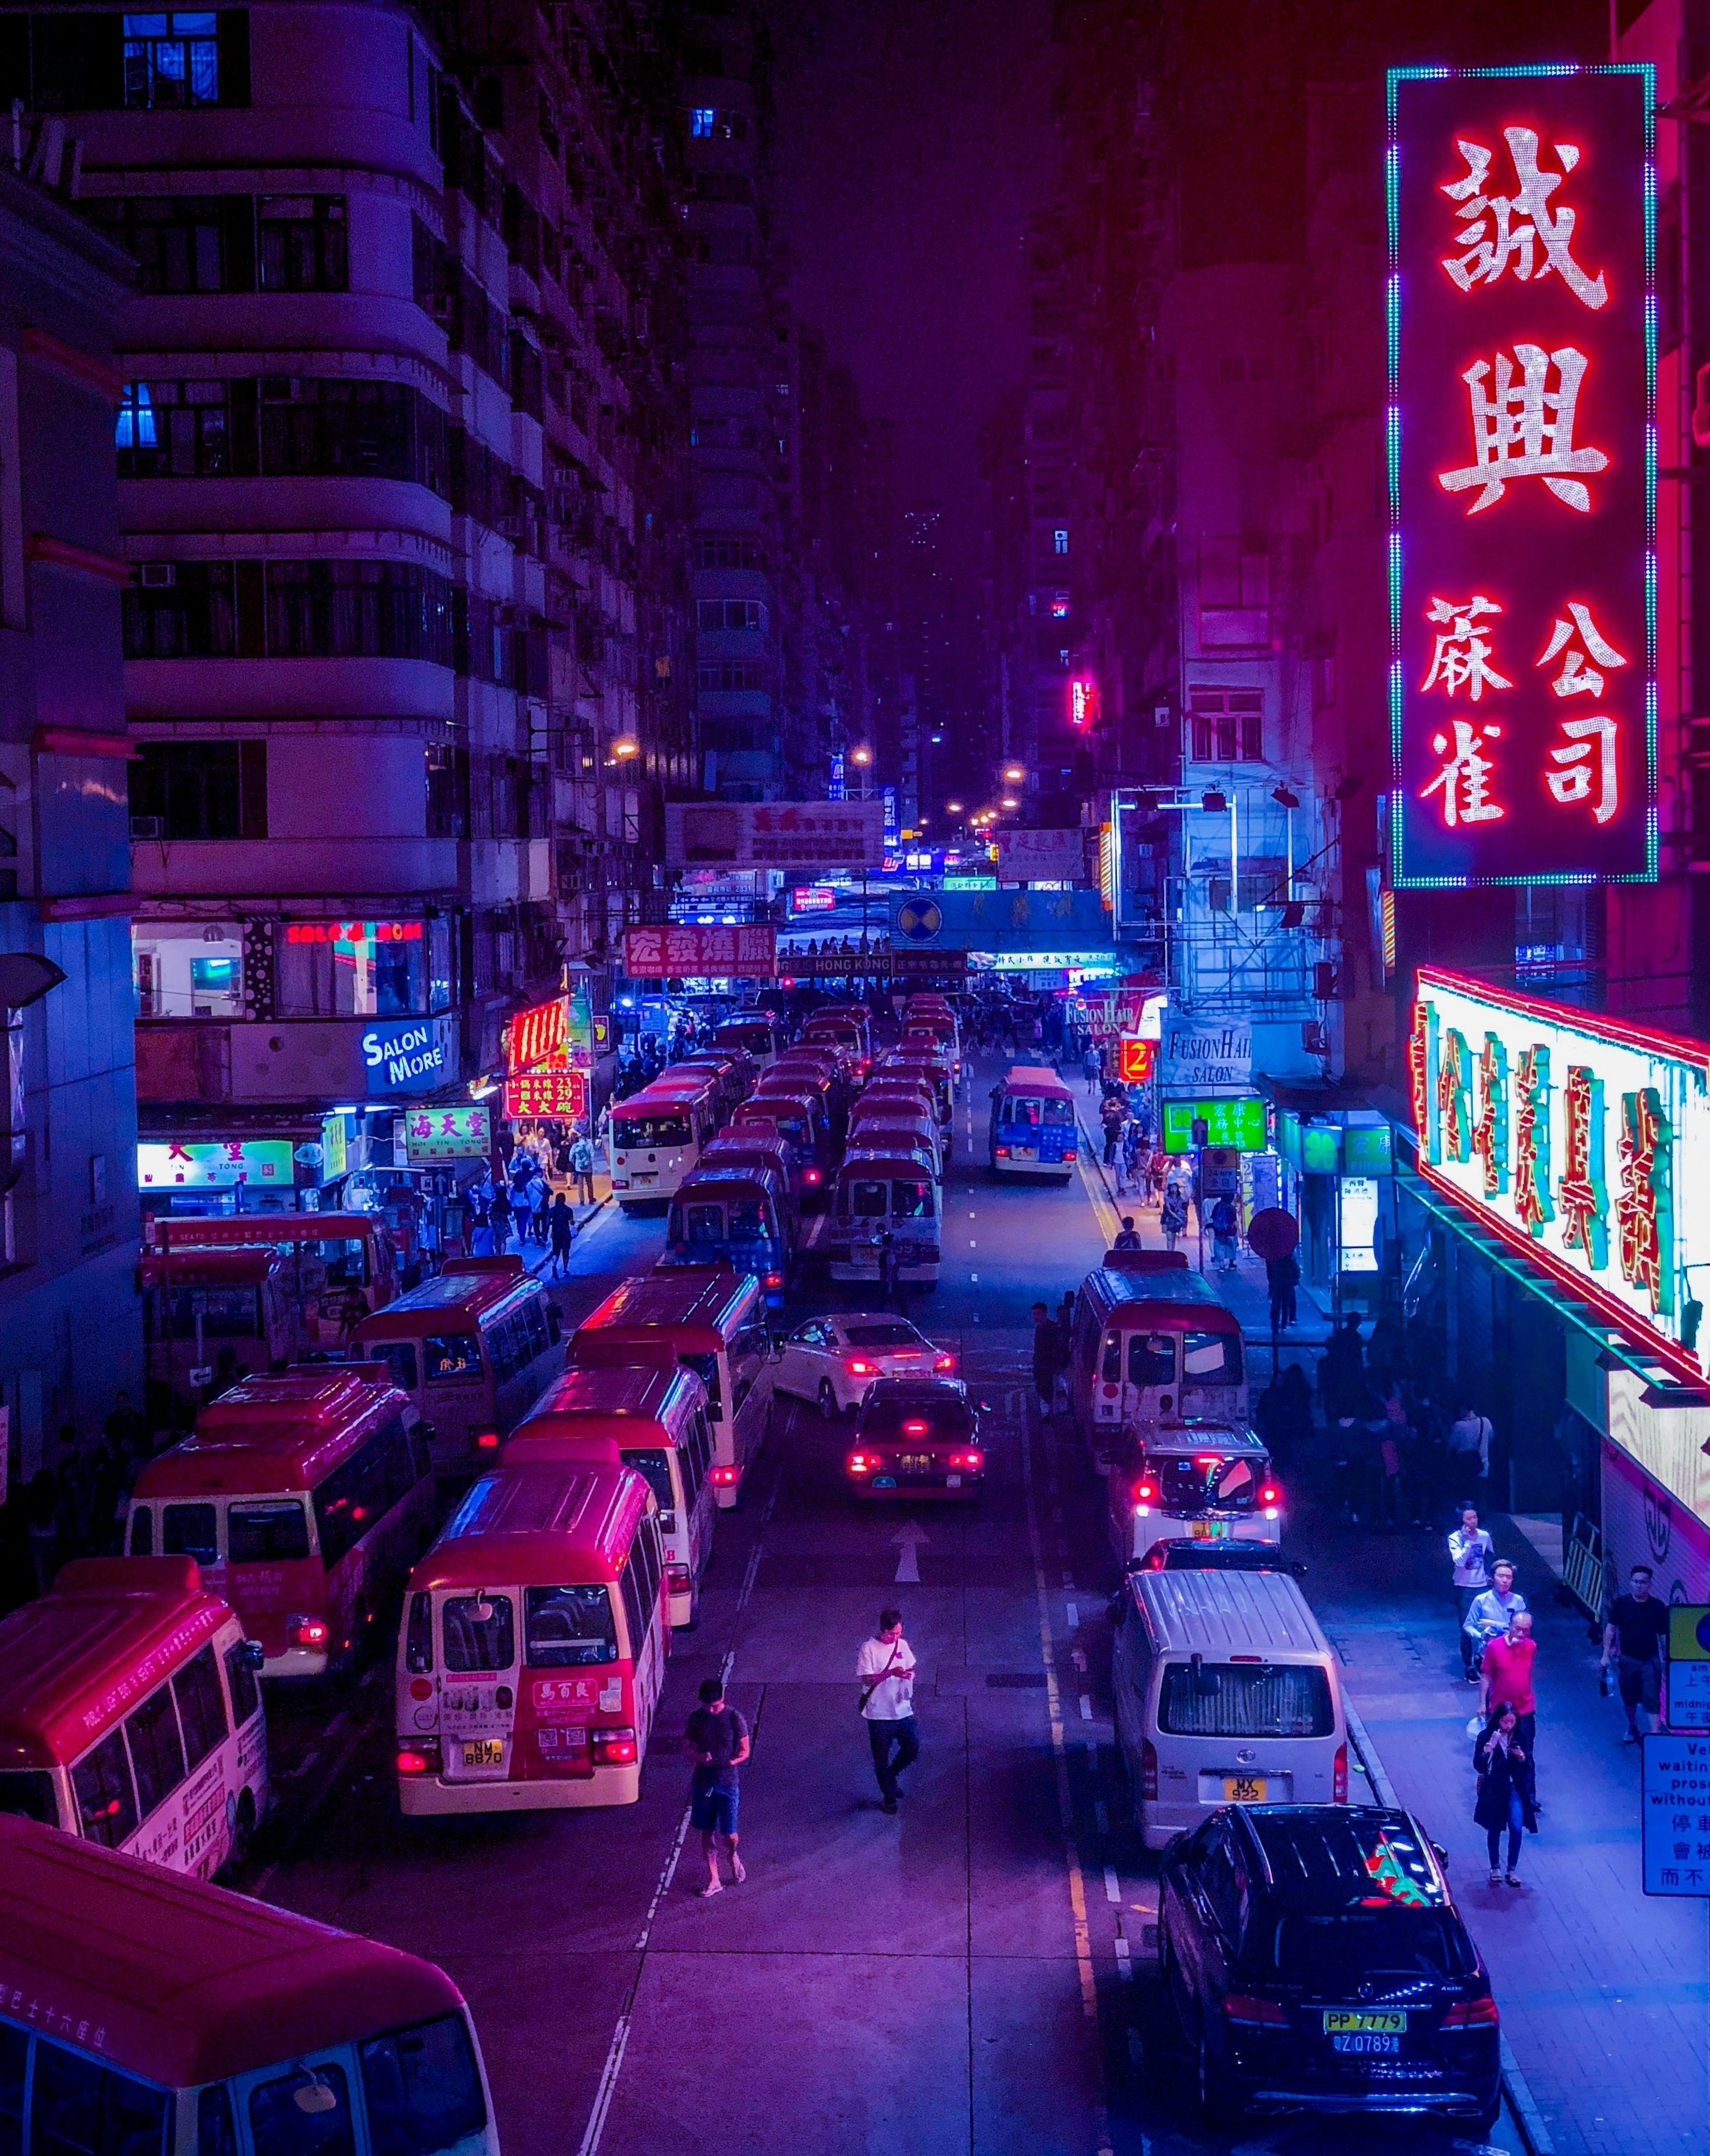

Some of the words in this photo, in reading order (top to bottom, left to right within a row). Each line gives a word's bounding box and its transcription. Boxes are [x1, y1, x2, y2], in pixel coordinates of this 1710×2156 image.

[1535, 602, 1629, 824] 公司
[815, 959, 852, 971] HONG
[854, 959, 890, 970] KONG
[1076, 1023, 1120, 1036] SALON
[363, 1026, 428, 1066] SALON
[1169, 1031, 1221, 1059] FUSION
[1128, 1042, 1147, 1071] 2
[389, 1047, 443, 1084] MORE
[1193, 1066, 1233, 1083] SALON
[556, 1077, 572, 1089] 23
[556, 1089, 573, 1100] 29
[410, 1111, 488, 1139] 海天堂
[1208, 1117, 1261, 1130] 務中心
[474, 1742, 493, 1754] NM
[466, 1753, 502, 1765] 8870
[1236, 1779, 1254, 1790] MX
[1232, 1789, 1260, 1801] 922
[1672, 1814, 1710, 1833] 停車
[1328, 2013, 1350, 2028] PP
[1357, 2013, 1401, 2029] 7779
[1355, 2036, 1390, 2051] 0789
